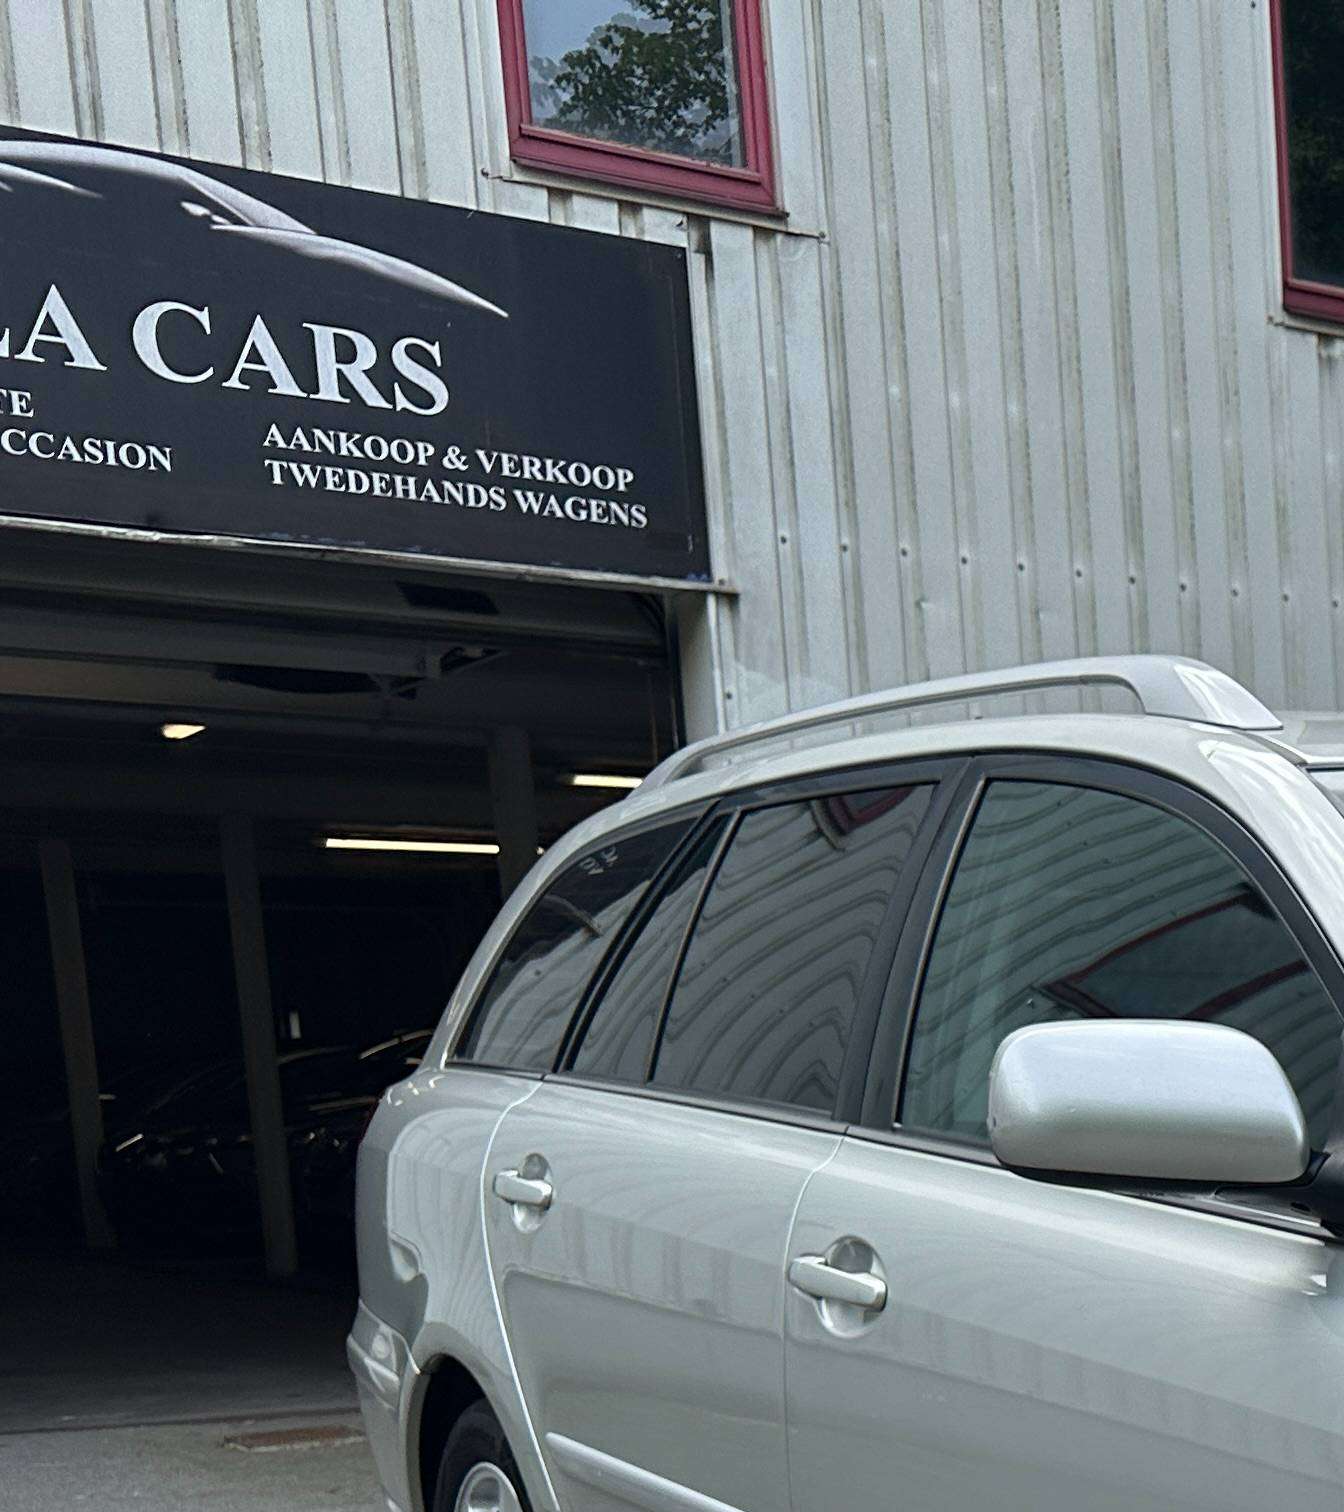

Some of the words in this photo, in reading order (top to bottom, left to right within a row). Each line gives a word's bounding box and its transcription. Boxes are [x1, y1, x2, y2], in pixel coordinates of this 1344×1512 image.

[132, 300, 450, 416] CARS
[262, 423, 436, 467] AANKOOP
[442, 445, 469, 471] &
[475, 448, 635, 493] VERKOOP
[263, 459, 507, 511] TWEDEHANDS
[512, 488, 649, 529] WAGENS
